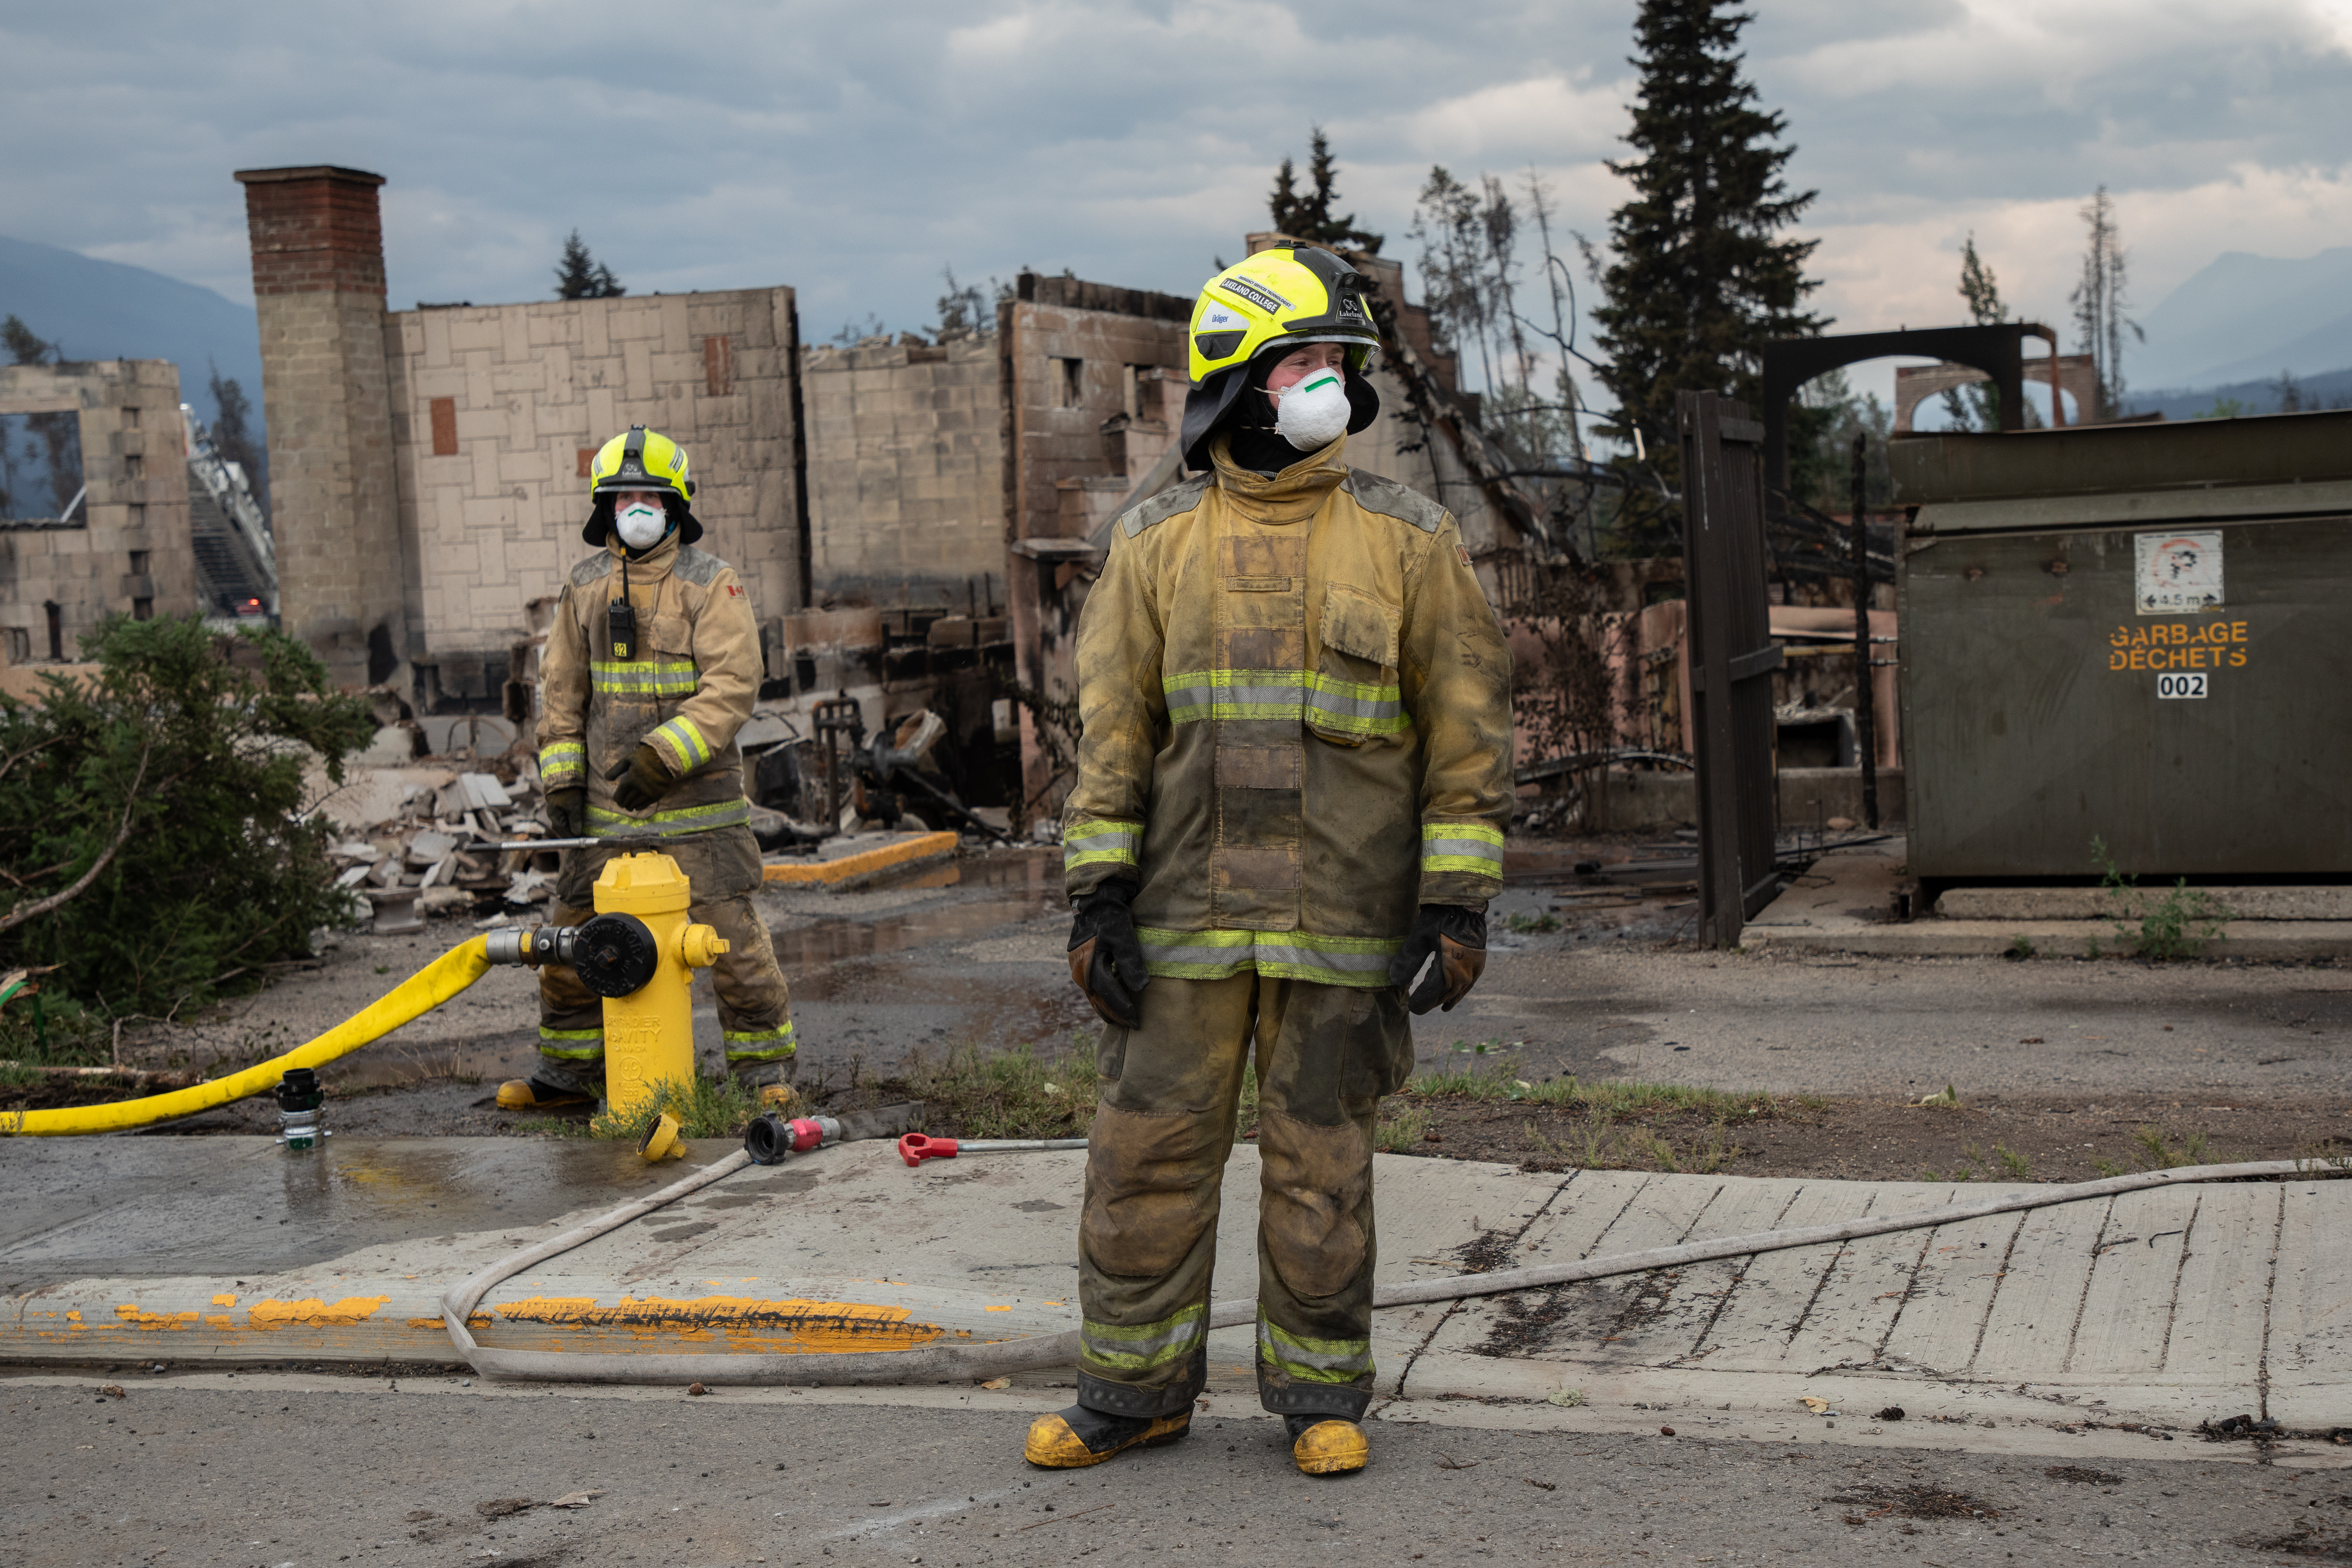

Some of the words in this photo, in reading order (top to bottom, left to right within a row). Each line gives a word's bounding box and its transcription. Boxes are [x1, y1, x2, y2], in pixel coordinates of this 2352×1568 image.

[1221, 279, 1250, 296] LAKELAND
[1248, 291, 1278, 312] COLLEGE
[1238, 276, 1254, 285] EMERGENCY
[1253, 283, 1267, 292] SERVICES
[1266, 290, 1292, 308] TECHNOLOGIST
[1212, 314, 1228, 323] Dräger
[2187, 596, 2200, 605] m
[2109, 621, 2248, 647] GARBAGE
[615, 644, 625, 655] 32
[2161, 676, 2204, 695] 002
[606, 1015, 661, 1028] BRIGADIER
[614, 1043, 647, 1053] CANADA
